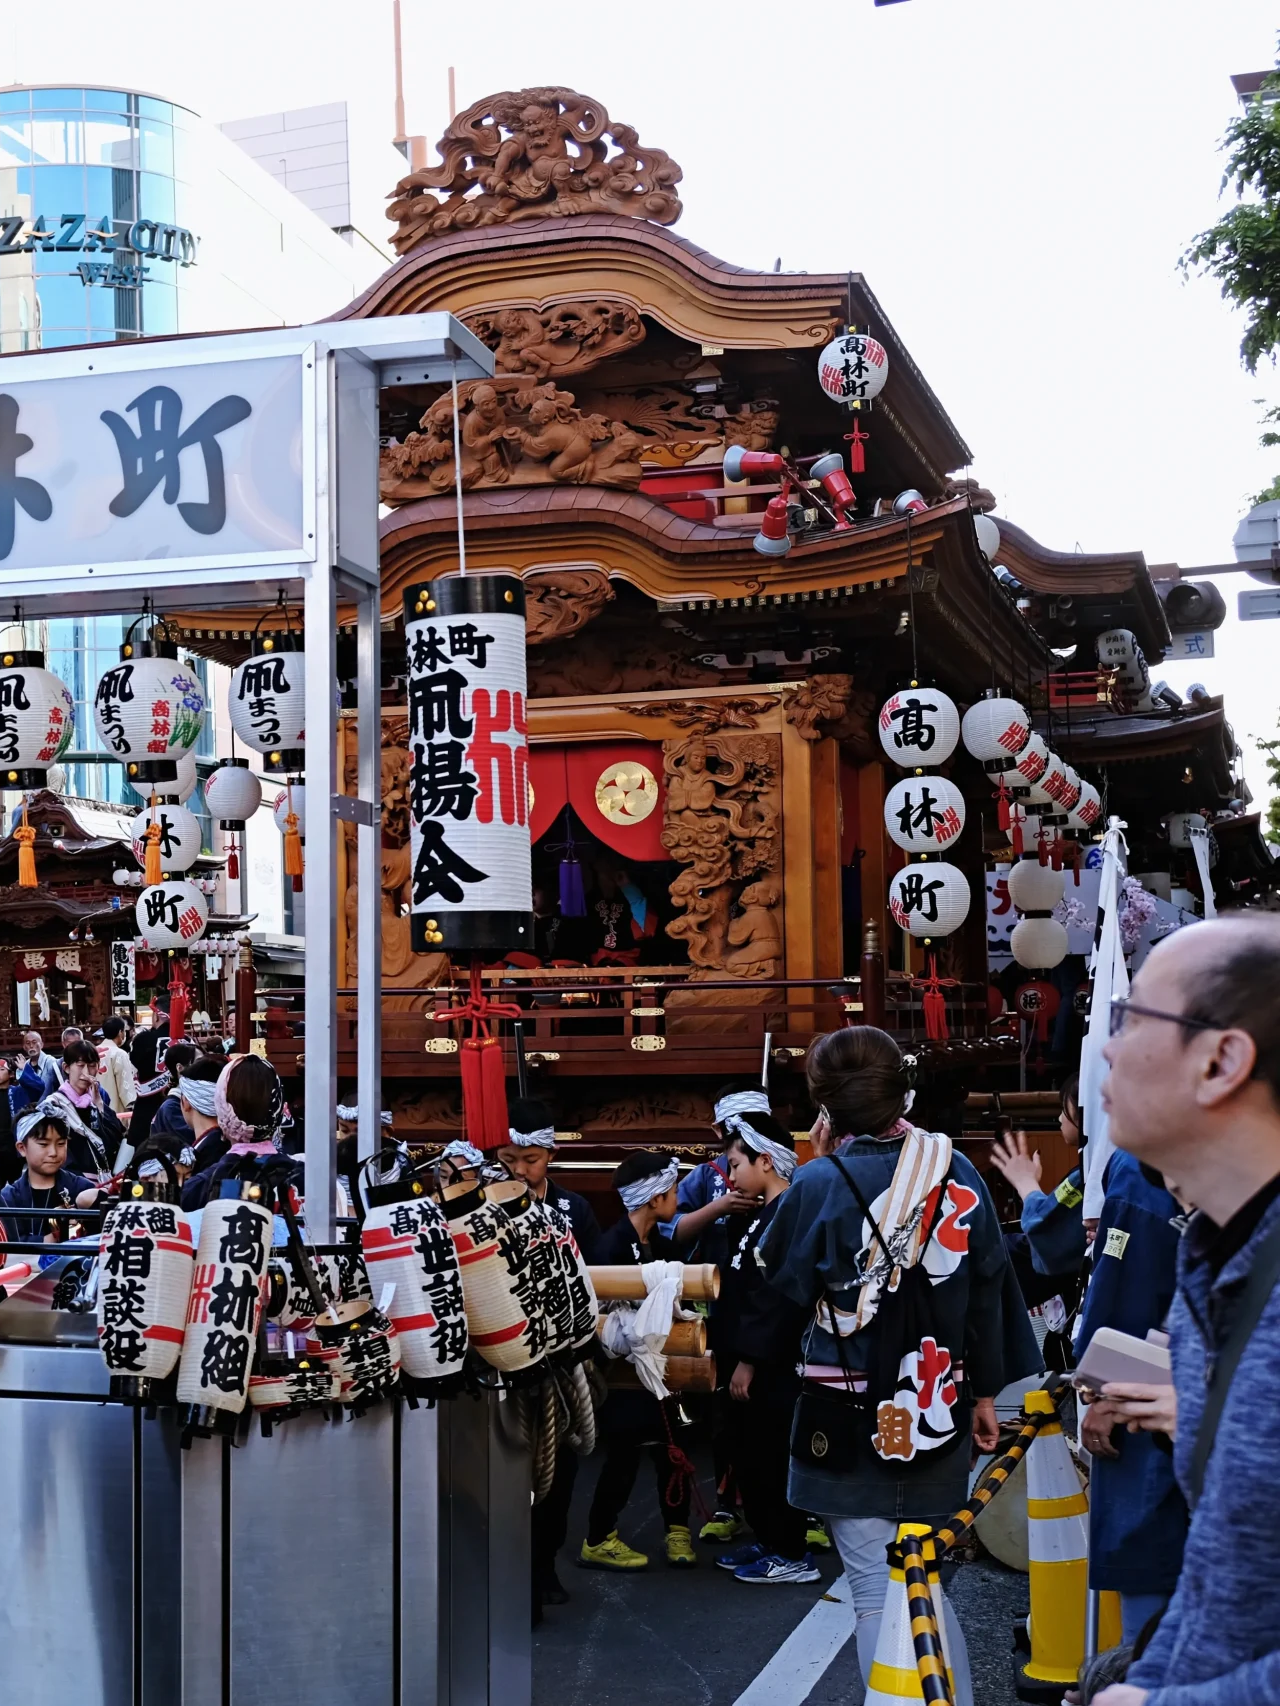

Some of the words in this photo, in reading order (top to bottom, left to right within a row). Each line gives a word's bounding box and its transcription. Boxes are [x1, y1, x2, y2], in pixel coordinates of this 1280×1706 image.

[77, 262, 150, 289] WEST
[128, 219, 199, 267] CITY
[405, 623, 495, 678] 林町
[95, 665, 134, 754] 凧まつり
[238, 657, 291, 745] 凧まつり
[101, 1231, 155, 1372] 相談役
[414, 1227, 469, 1365] 世話役
